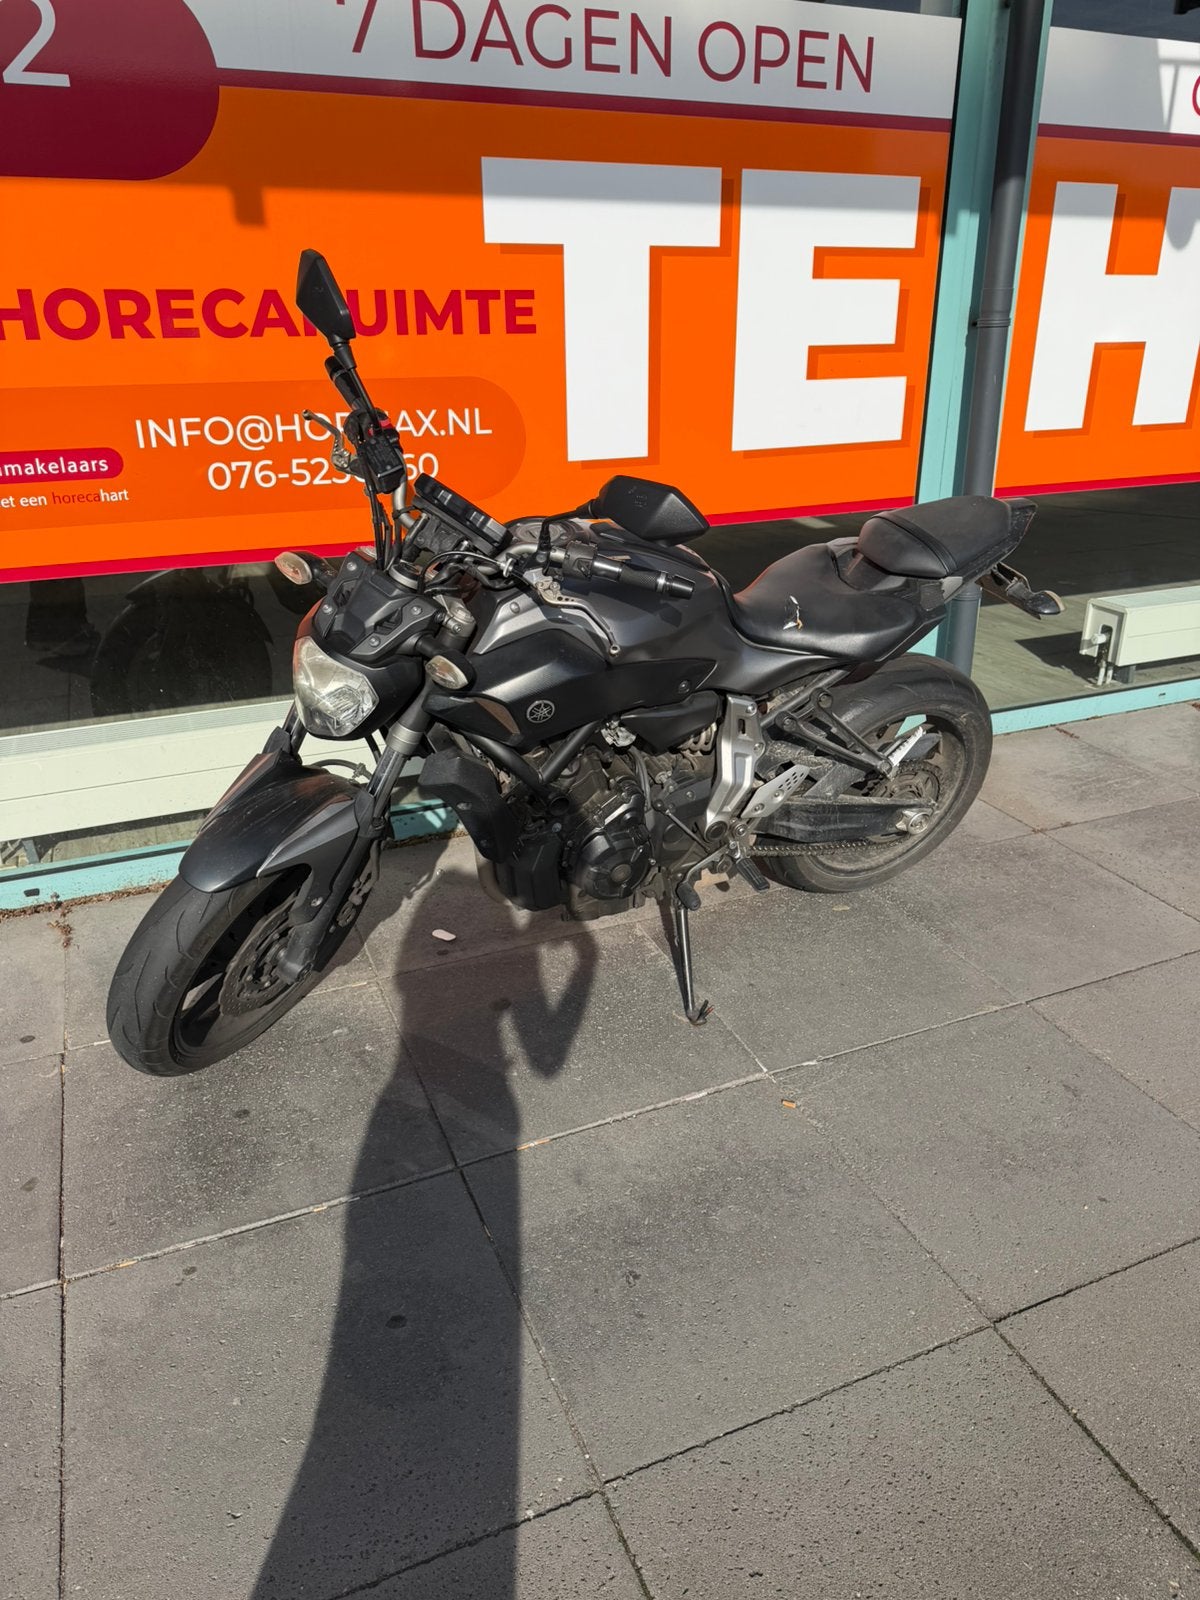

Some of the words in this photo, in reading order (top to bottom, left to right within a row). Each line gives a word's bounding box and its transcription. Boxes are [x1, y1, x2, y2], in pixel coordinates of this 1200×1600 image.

[2, 0, 71, 88] 2
[336, 0, 363, 53] 7
[412, 0, 671, 78] DAGEN
[698, 20, 875, 94] OPEN
[0, 288, 537, 340] HORECAUIMTE
[482, 156, 922, 461] TE
[1024, 181, 1200, 431] H
[20, 495, 47, 507] een
[52, 489, 129, 504] horecahart
